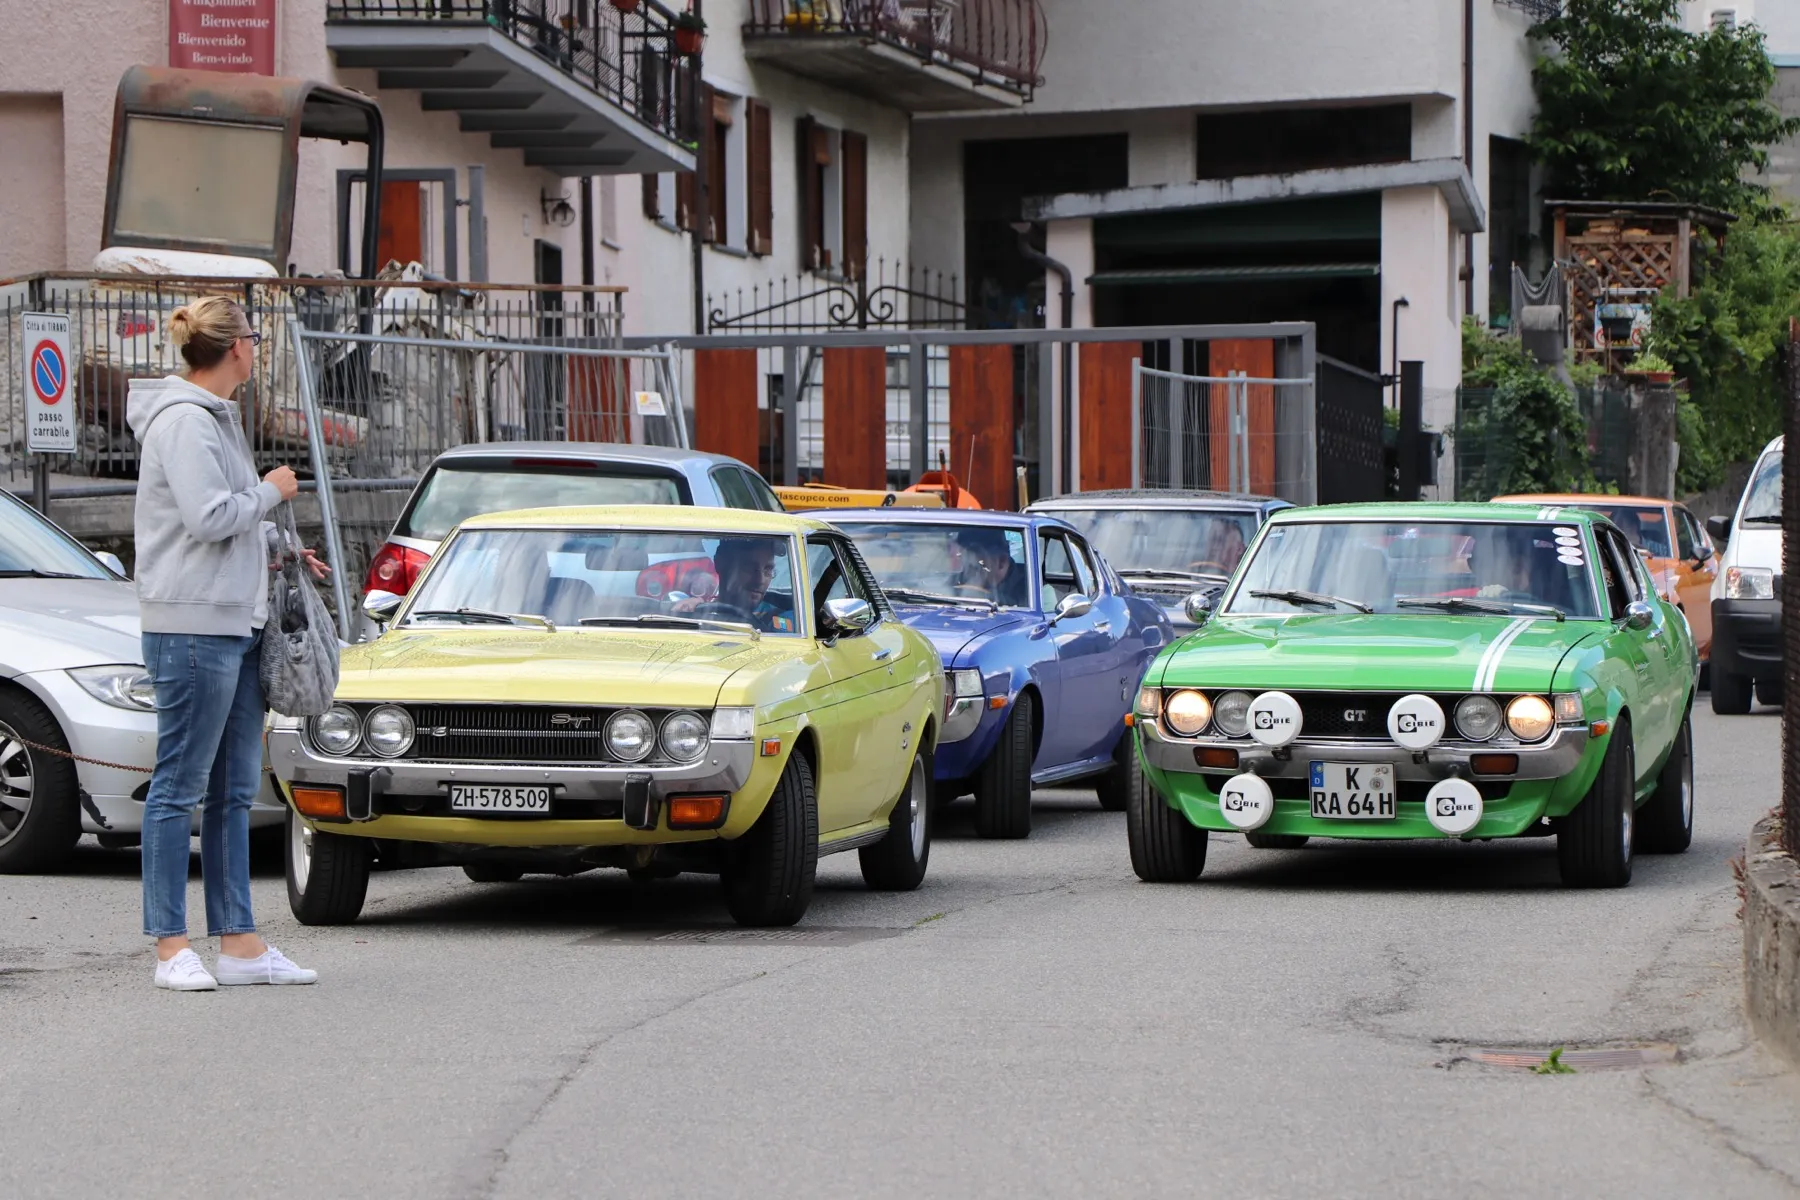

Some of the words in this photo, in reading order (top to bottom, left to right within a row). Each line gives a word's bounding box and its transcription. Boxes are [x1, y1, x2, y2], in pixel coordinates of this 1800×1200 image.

[201, 13, 270, 28] Bienvenue
[177, 32, 246, 46] Bienvenido
[192, 51, 253, 64] Bem-vindo
[38, 412, 63, 424] passo
[32, 426, 70, 438] carrabile
[1344, 709, 1366, 722] GT
[1314, 777, 1321, 785] D
[1345, 767, 1361, 790] K
[1313, 791, 1342, 815] RA
